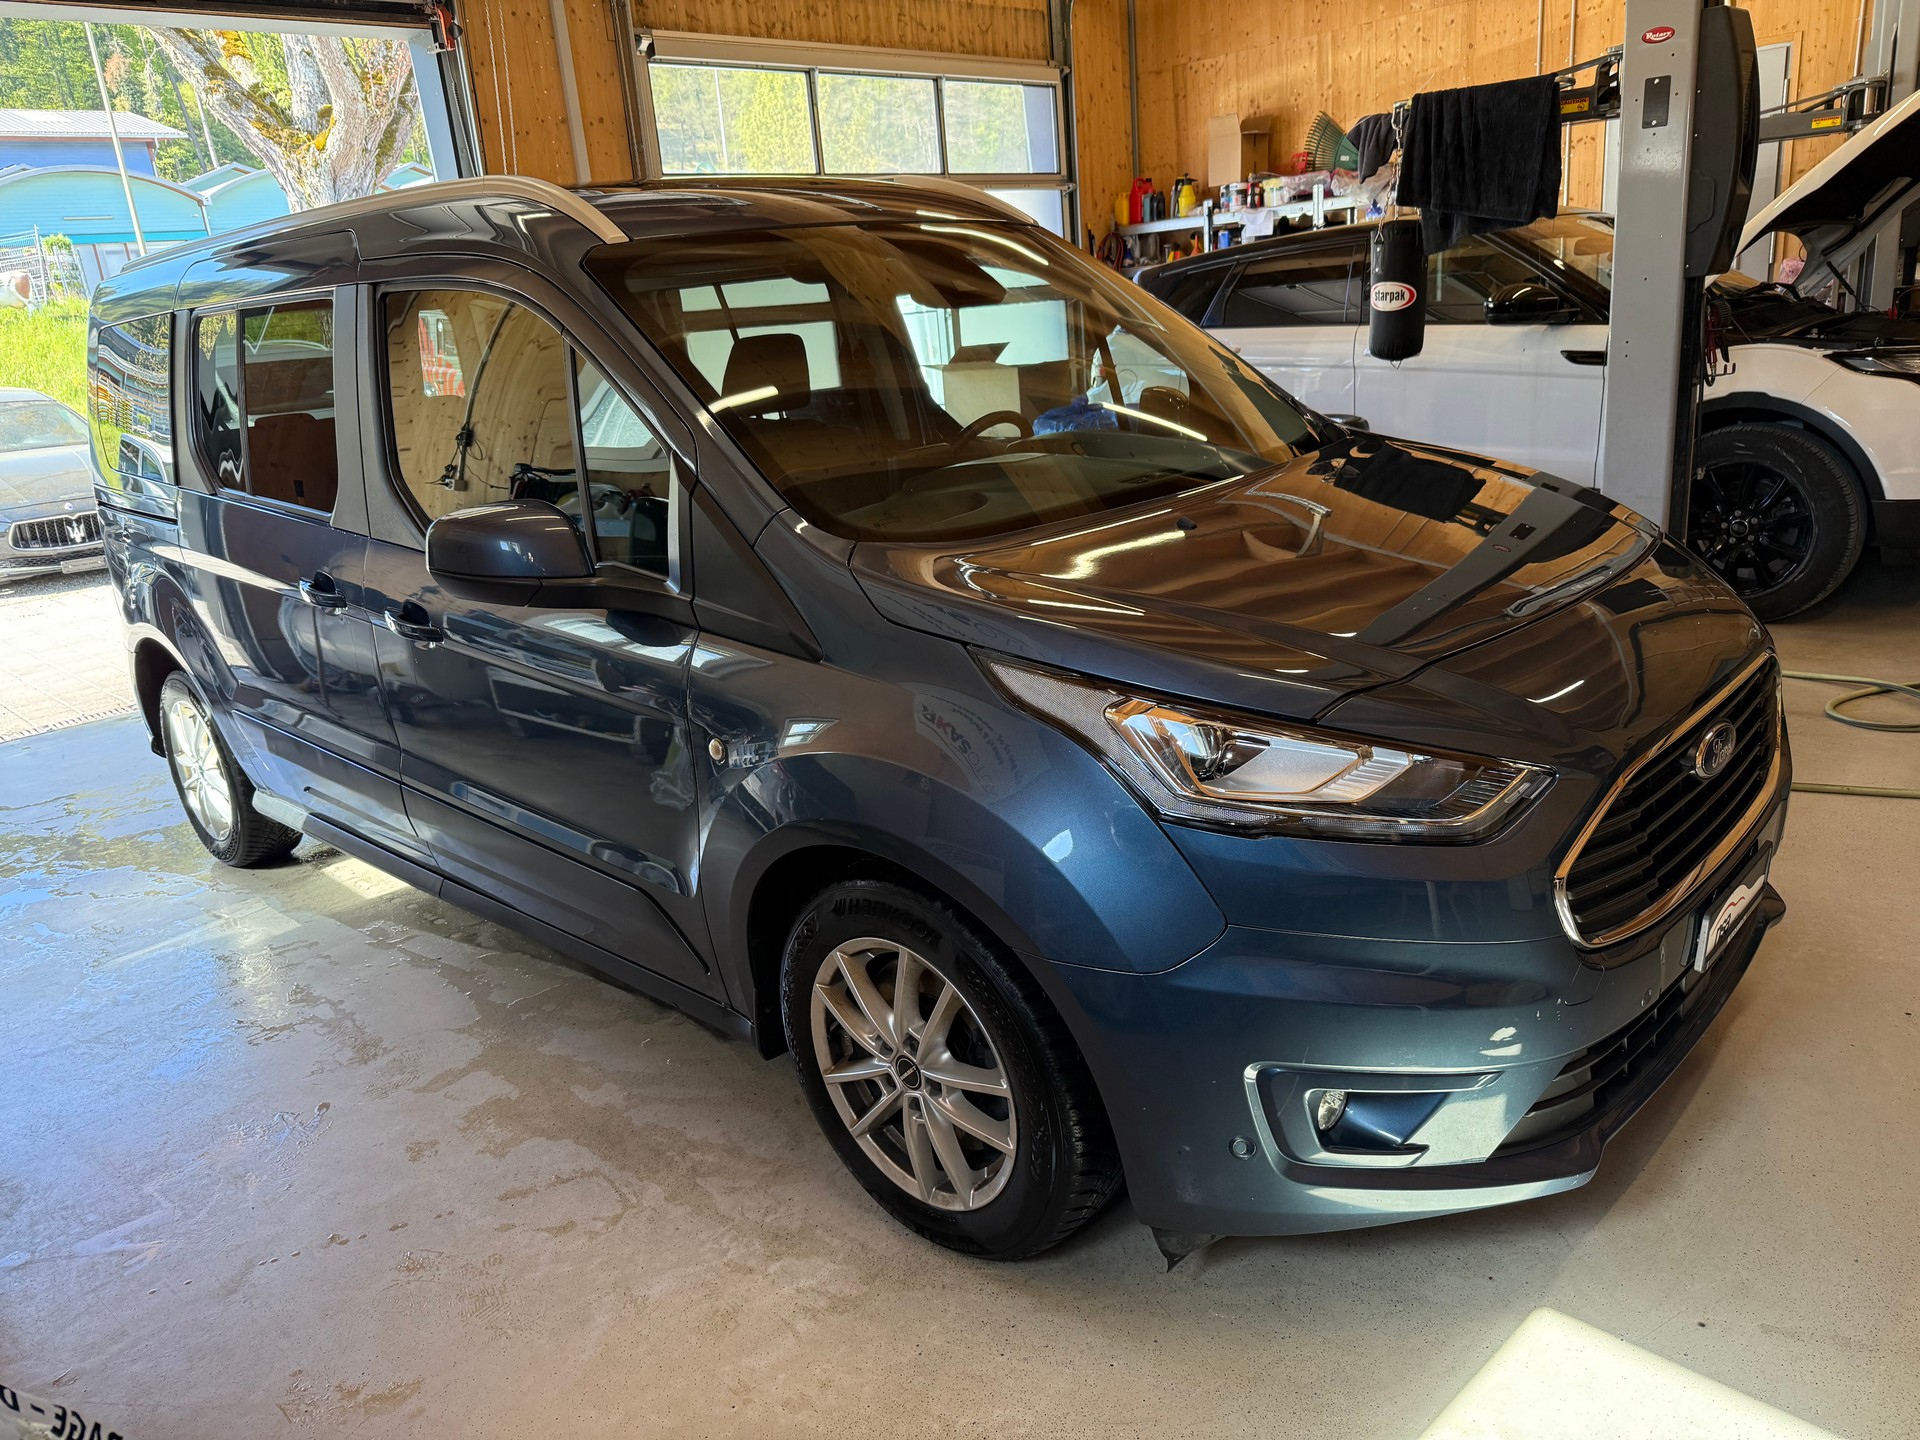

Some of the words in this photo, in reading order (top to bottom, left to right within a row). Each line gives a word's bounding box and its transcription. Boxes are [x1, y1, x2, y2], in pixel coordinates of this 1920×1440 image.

[1645, 31, 1672, 41] Rotary
[1374, 289, 1406, 303] starpak
[1711, 732, 1732, 769] Ford
